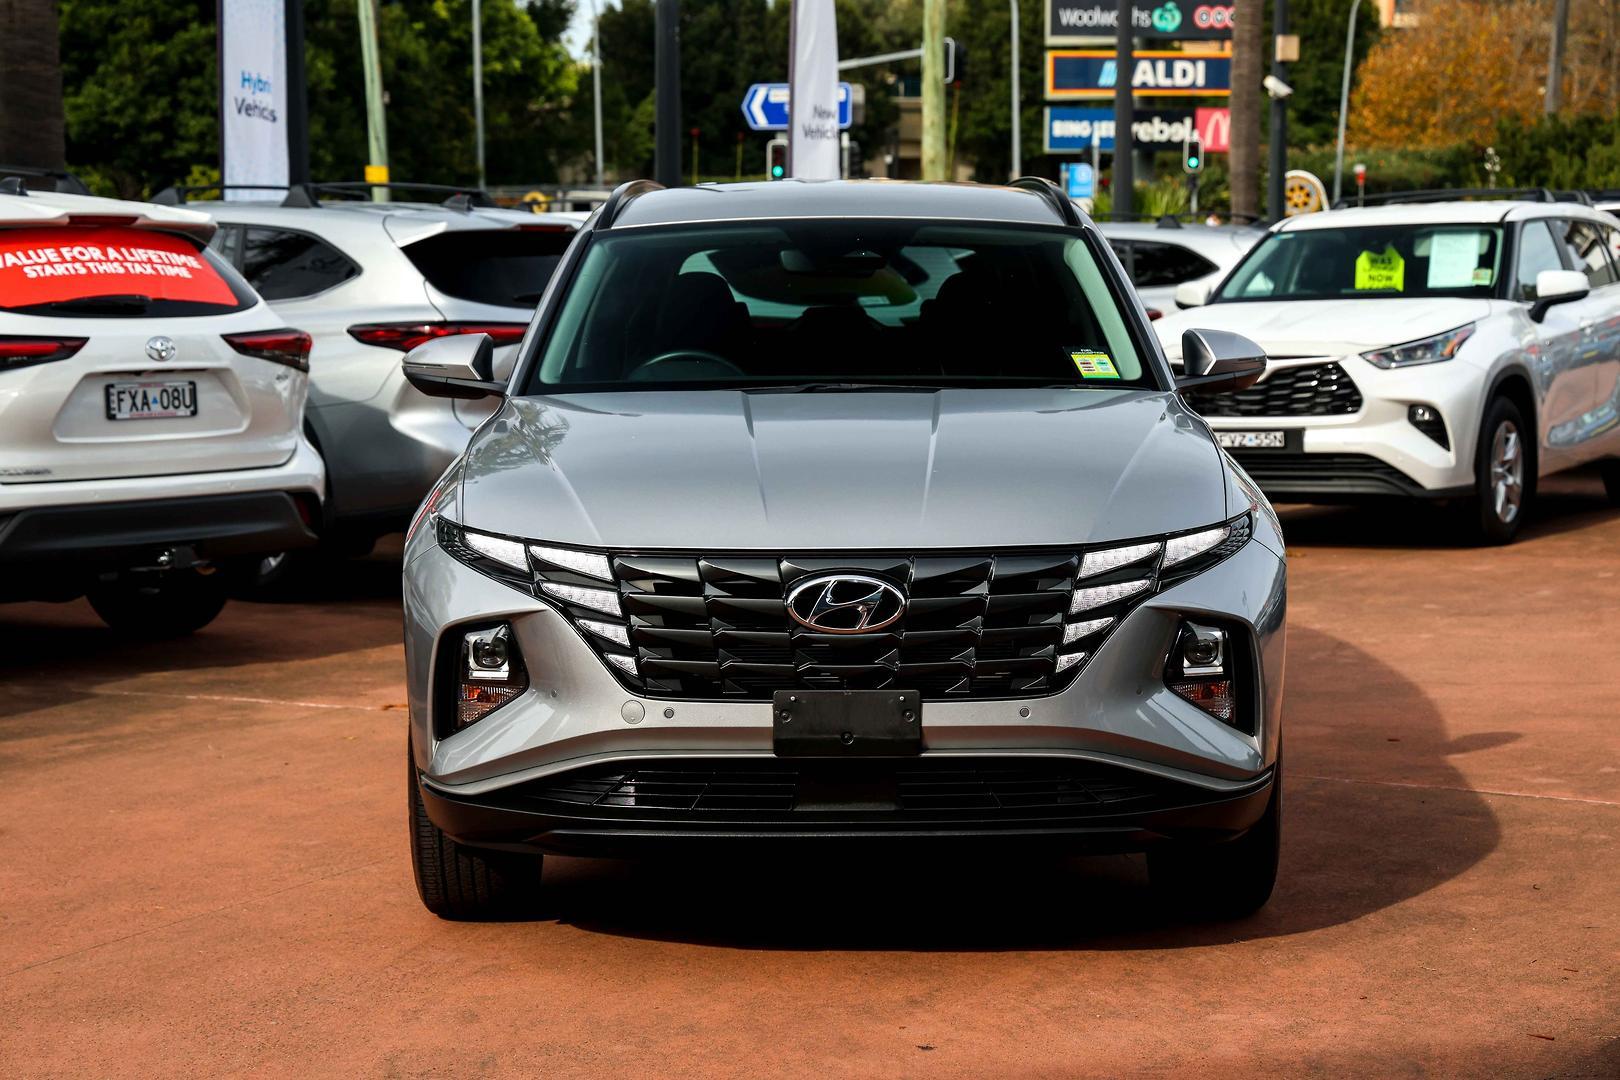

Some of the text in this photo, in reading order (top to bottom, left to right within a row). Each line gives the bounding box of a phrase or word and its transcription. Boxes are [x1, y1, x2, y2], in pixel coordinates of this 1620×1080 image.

[1059, 6, 1150, 27] Woolwohs
[241, 70, 272, 94] Hybri
[1132, 60, 1206, 87] ALDI
[61, 246, 108, 262] FOR
[105, 247, 121, 261] A
[120, 248, 203, 269] LIFETIME
[23, 262, 193, 279] STARTS THIS TAX TIME
[1368, 274, 1394, 282] NOW
[116, 387, 193, 413] FXA 08U
